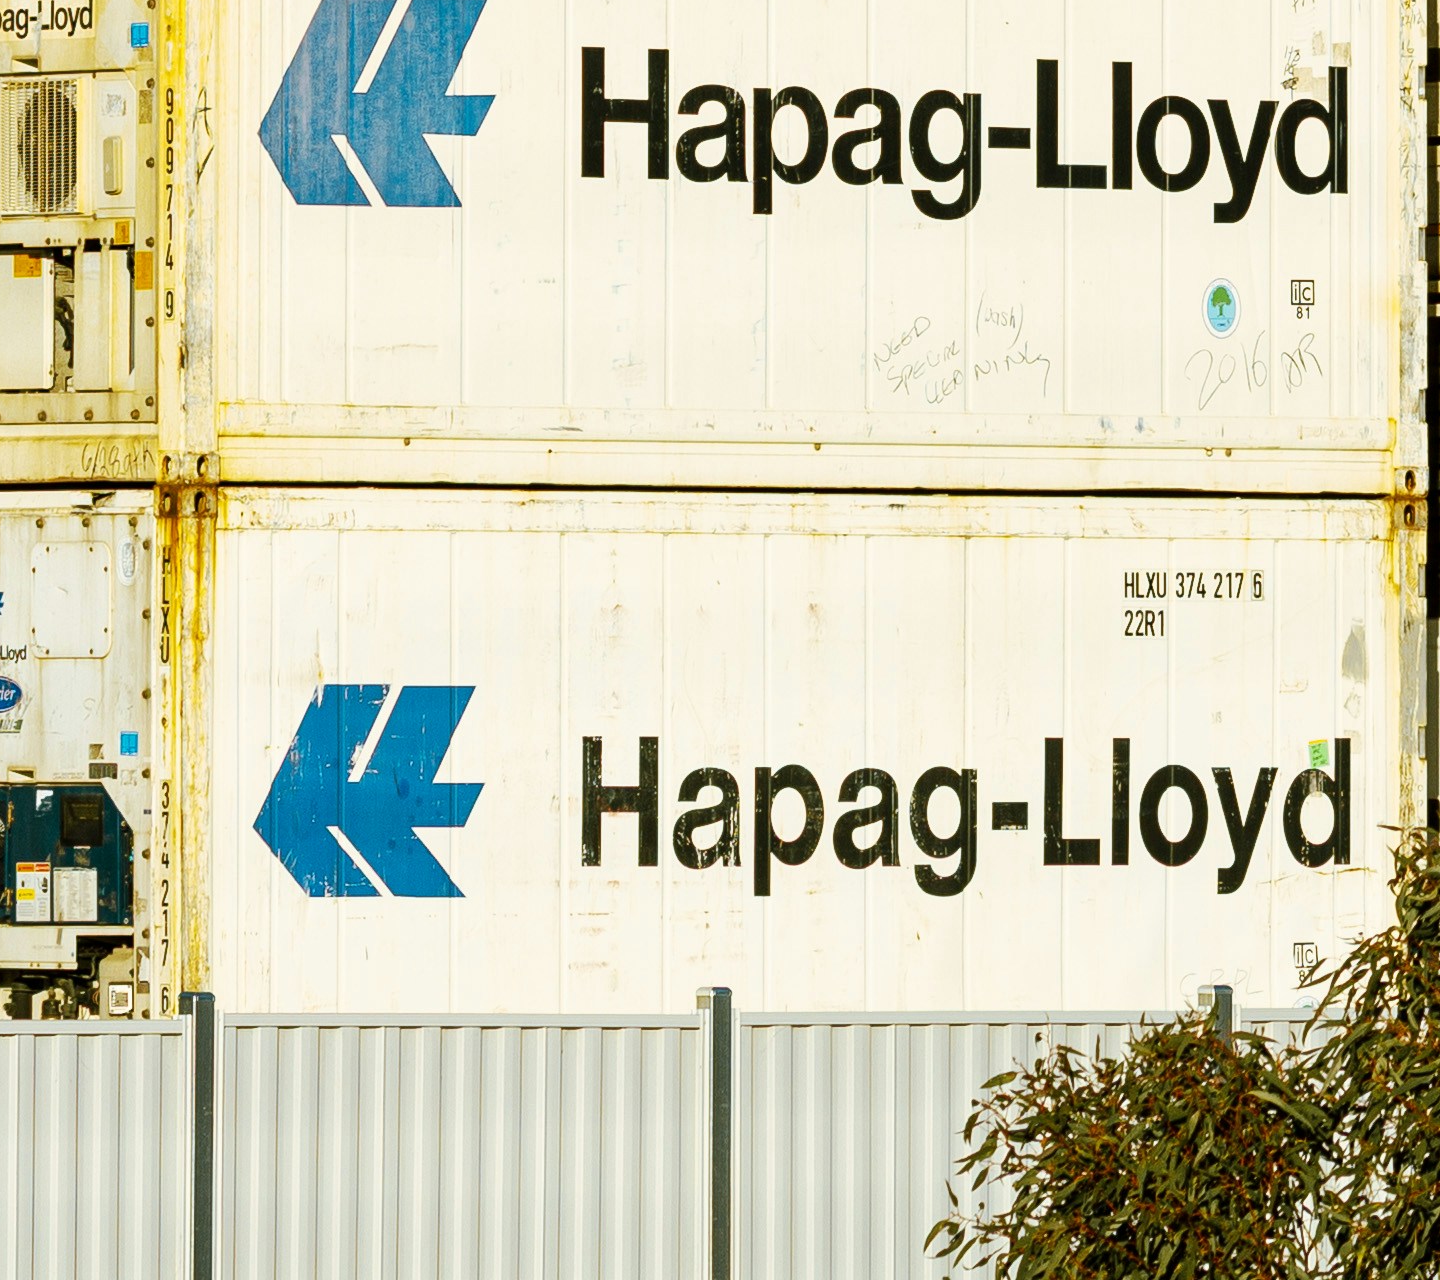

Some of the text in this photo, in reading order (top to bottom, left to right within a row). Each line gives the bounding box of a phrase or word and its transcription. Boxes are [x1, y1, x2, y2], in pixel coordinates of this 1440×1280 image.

[580, 45, 1349, 224] Hapag-Lloyd
[164, 87, 174, 271] 909 714
[1296, 306, 1311, 320] 81
[1124, 572, 1262, 599] HLXU 374 217 6
[1124, 610, 1165, 637] 22R1
[159, 781, 170, 869] 374
[581, 735, 1352, 898] Hapag-Lloyd
[159, 879, 169, 967] 217
